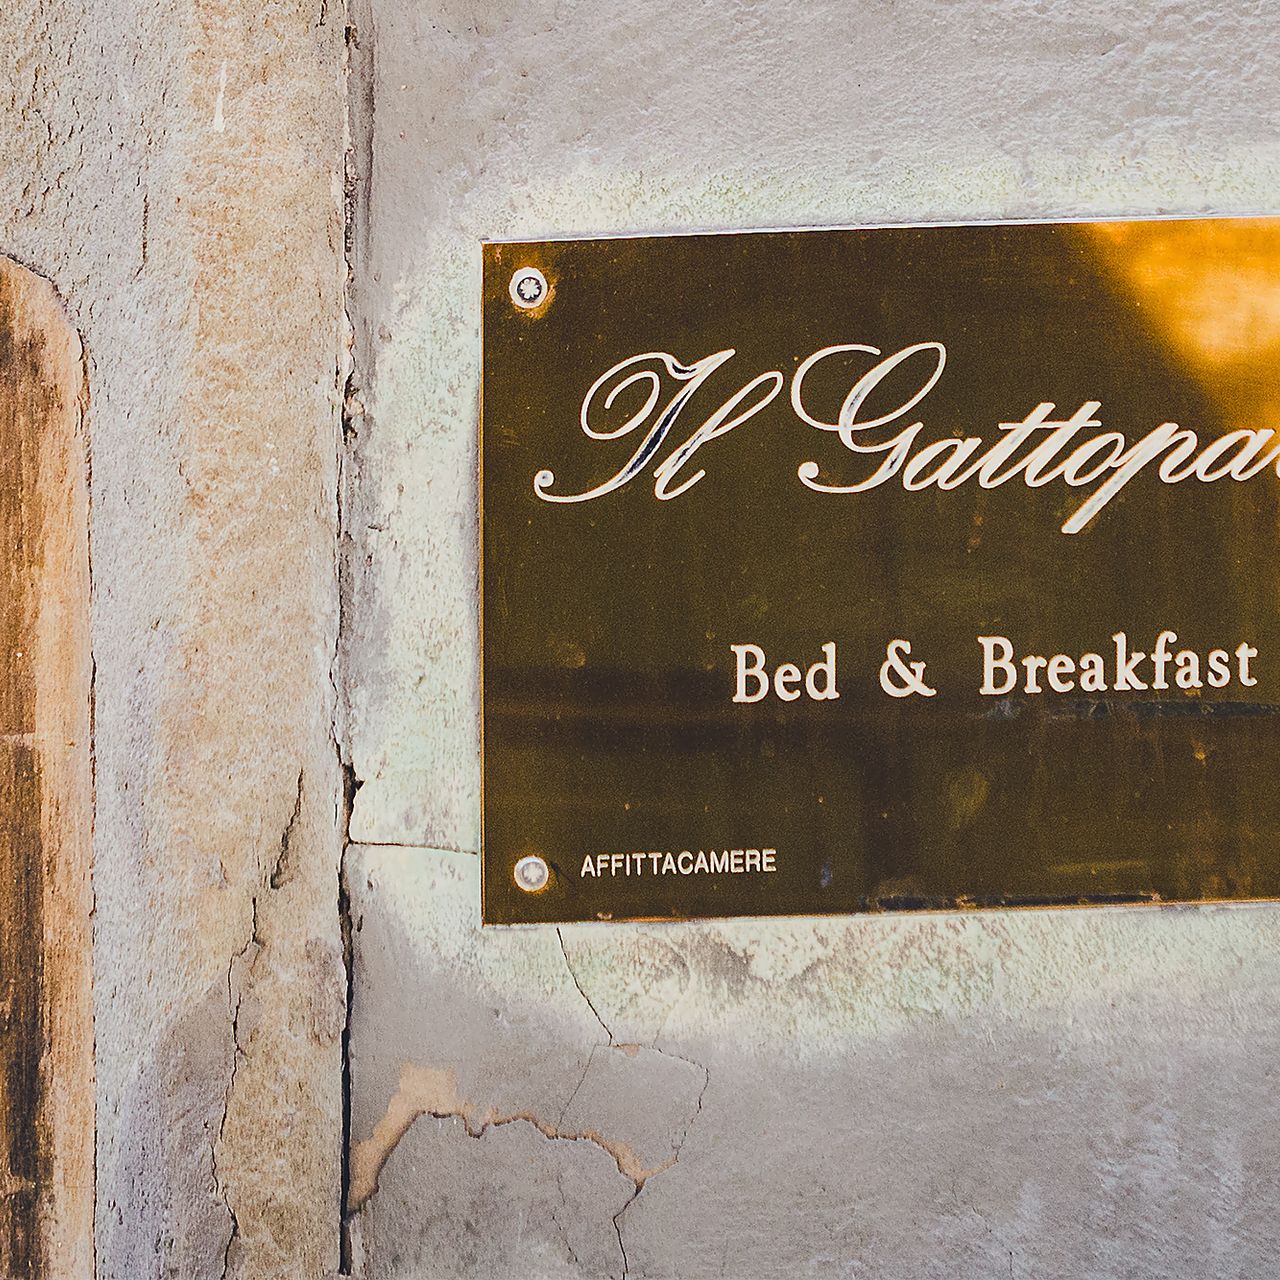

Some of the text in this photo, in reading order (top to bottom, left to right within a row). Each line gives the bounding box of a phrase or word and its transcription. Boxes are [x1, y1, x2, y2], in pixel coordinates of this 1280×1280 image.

[534, 348, 784, 504] Il
[731, 630, 1259, 704] Bed & Breakfast
[580, 848, 777, 877] AFFITTACAMERE
